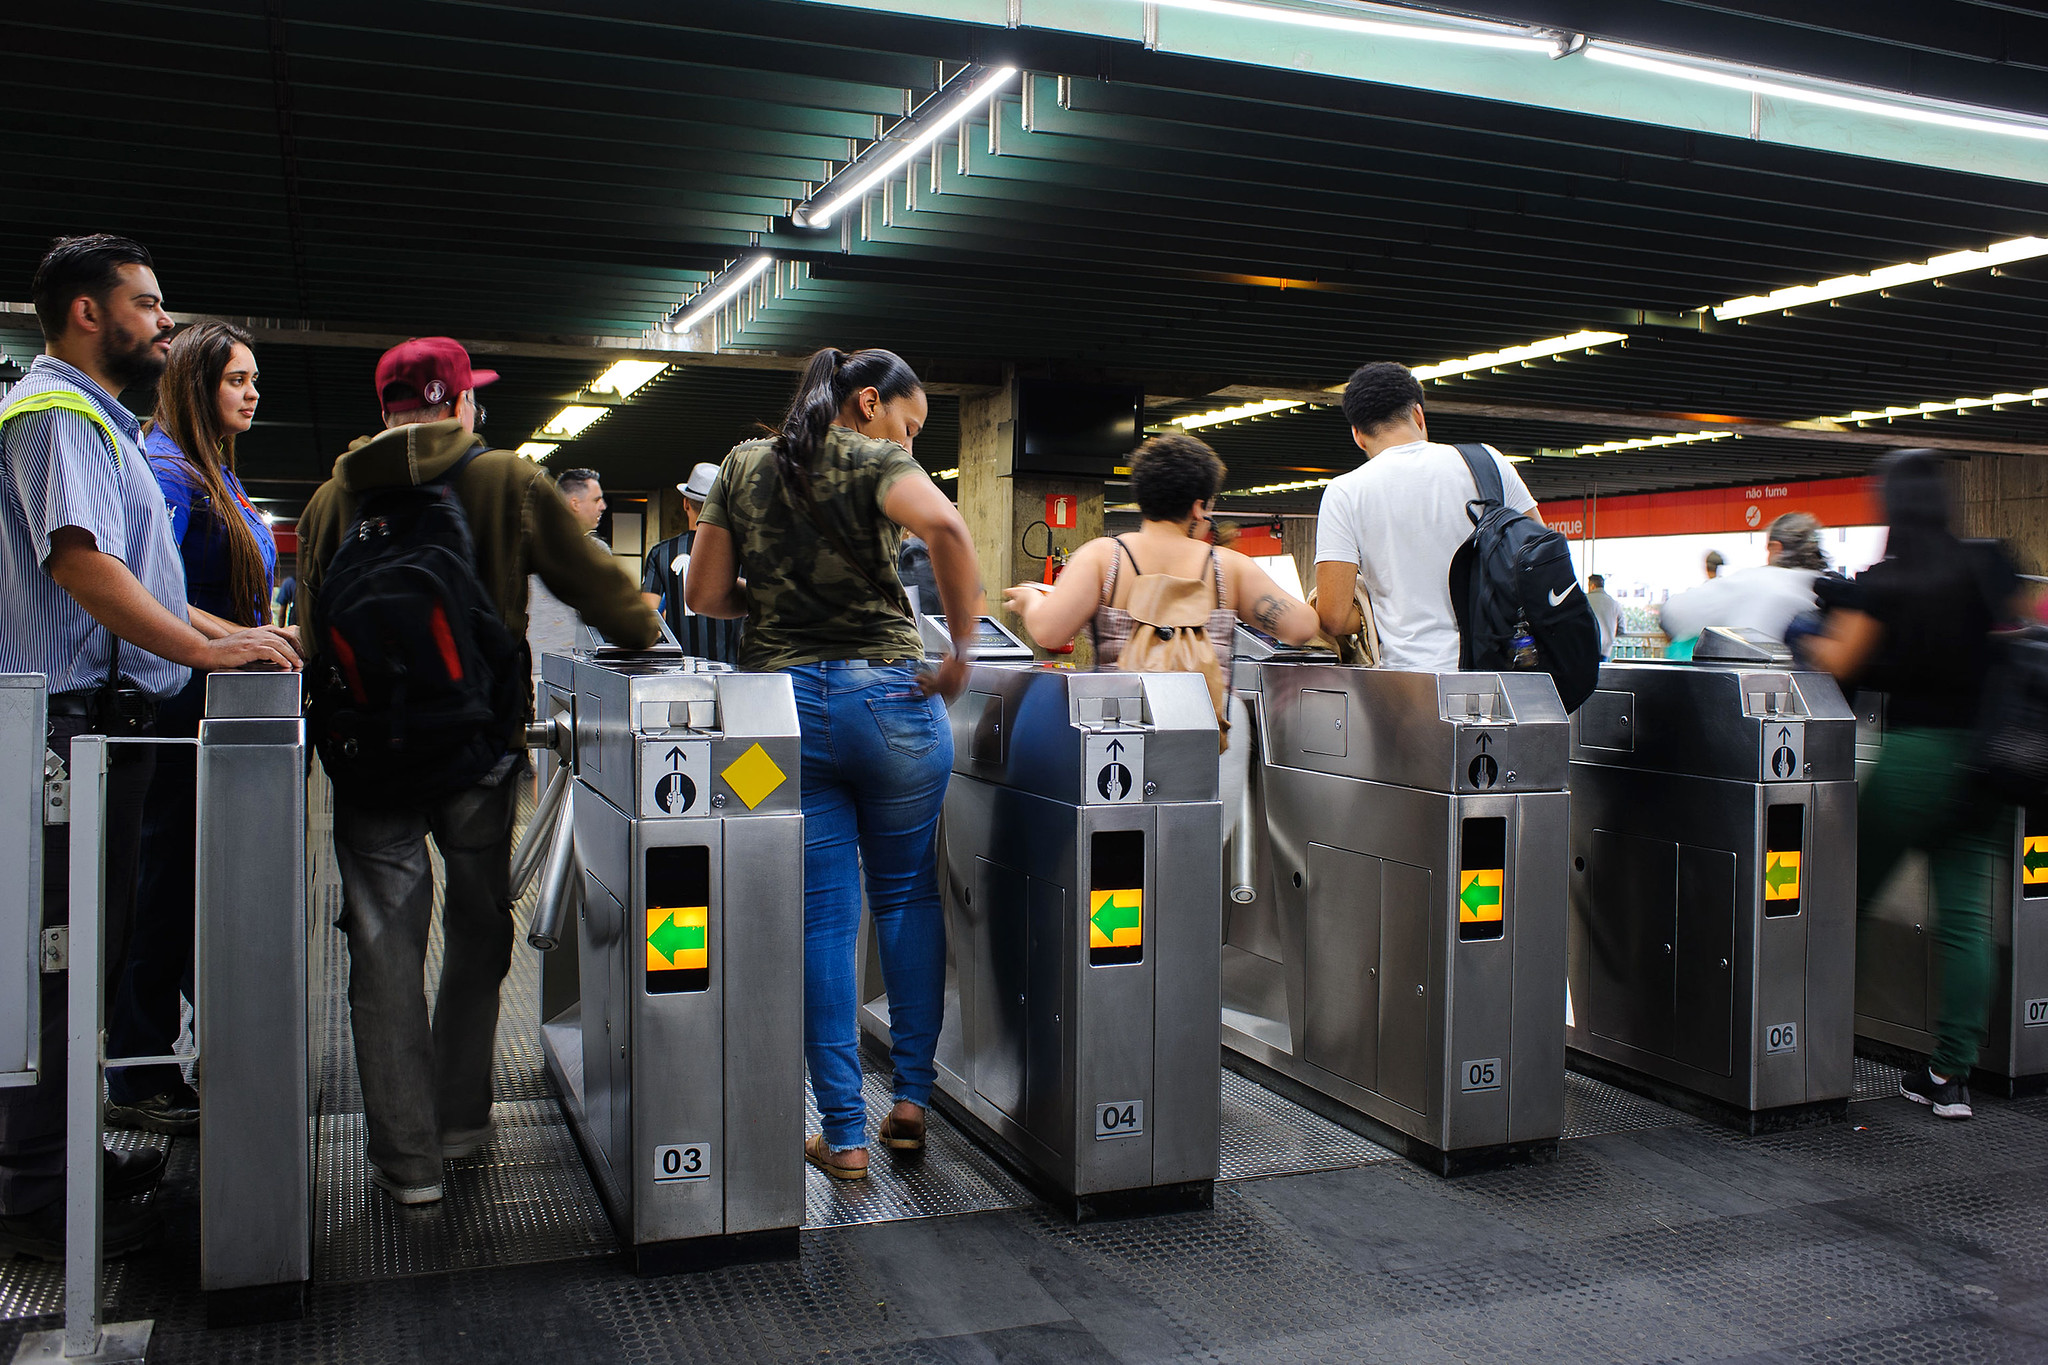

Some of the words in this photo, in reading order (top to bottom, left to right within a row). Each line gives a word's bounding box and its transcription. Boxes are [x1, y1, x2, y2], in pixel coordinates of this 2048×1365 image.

[1745, 488, 1762, 499] não
[1765, 486, 1788, 498] fume
[2030, 1002, 2048, 1020] 07
[1770, 1025, 1793, 1047] 06
[1469, 1063, 1494, 1085] 05
[1103, 1105, 1136, 1129] 04
[662, 1147, 702, 1174] 03
